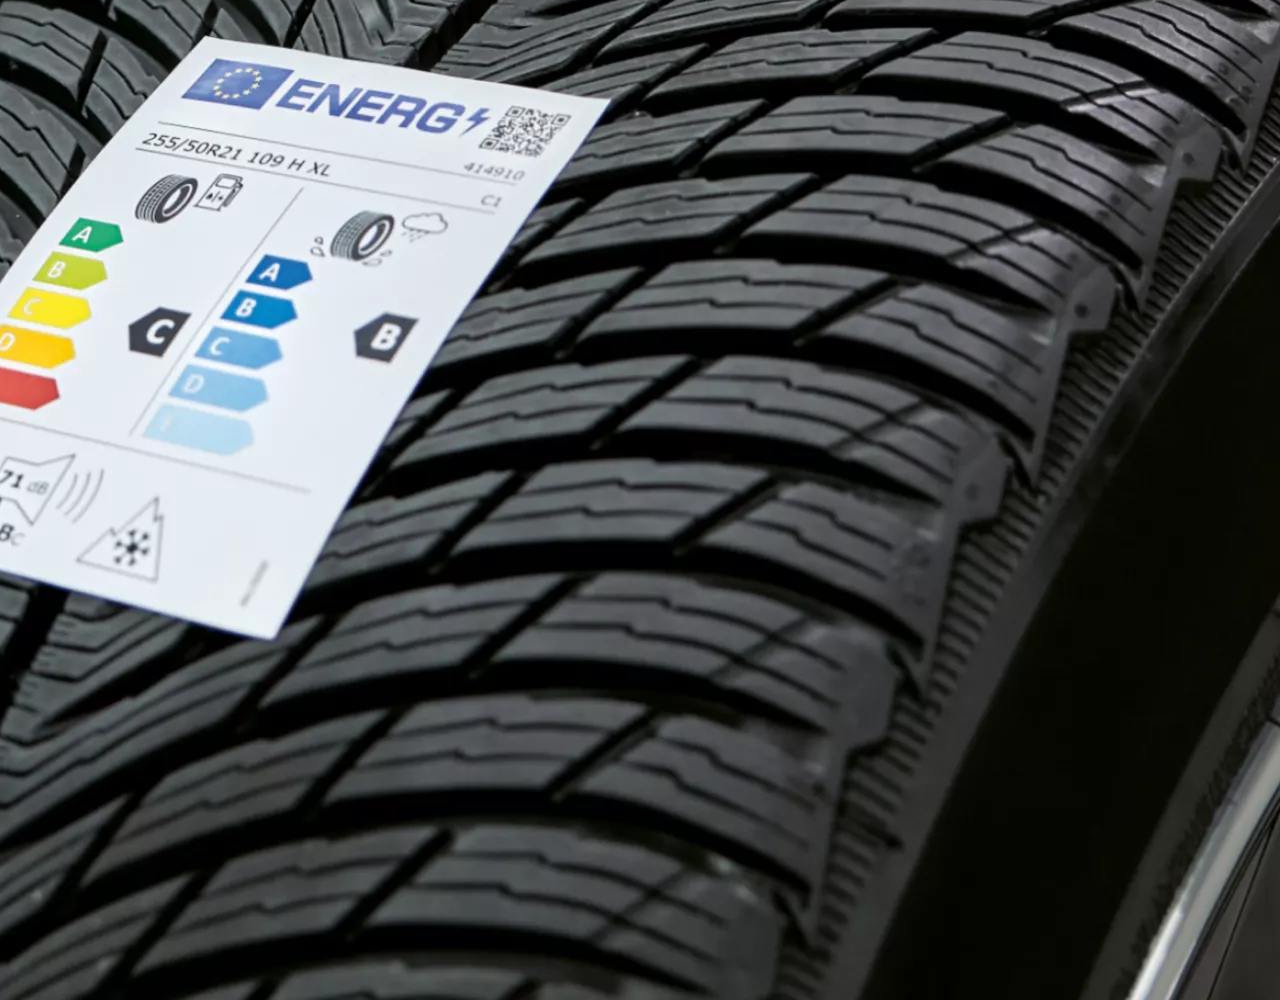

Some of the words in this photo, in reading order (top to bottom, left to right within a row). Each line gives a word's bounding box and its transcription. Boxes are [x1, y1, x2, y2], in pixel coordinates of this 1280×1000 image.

[276, 78, 465, 134] ENERG
[142, 132, 242, 161] 255/50R21
[247, 151, 285, 168] 109
[287, 158, 306, 172] H
[307, 161, 332, 177] XL
[463, 162, 525, 181] 414910
[72, 226, 93, 244] A
[47, 261, 66, 279] B
[259, 262, 281, 282] A
[23, 298, 41, 315] C
[235, 297, 257, 317] B
[146, 319, 175, 344] C
[370, 323, 403, 350] B
[210, 337, 230, 355] C
[181, 374, 204, 394] D
[26, 479, 50, 495] dB
